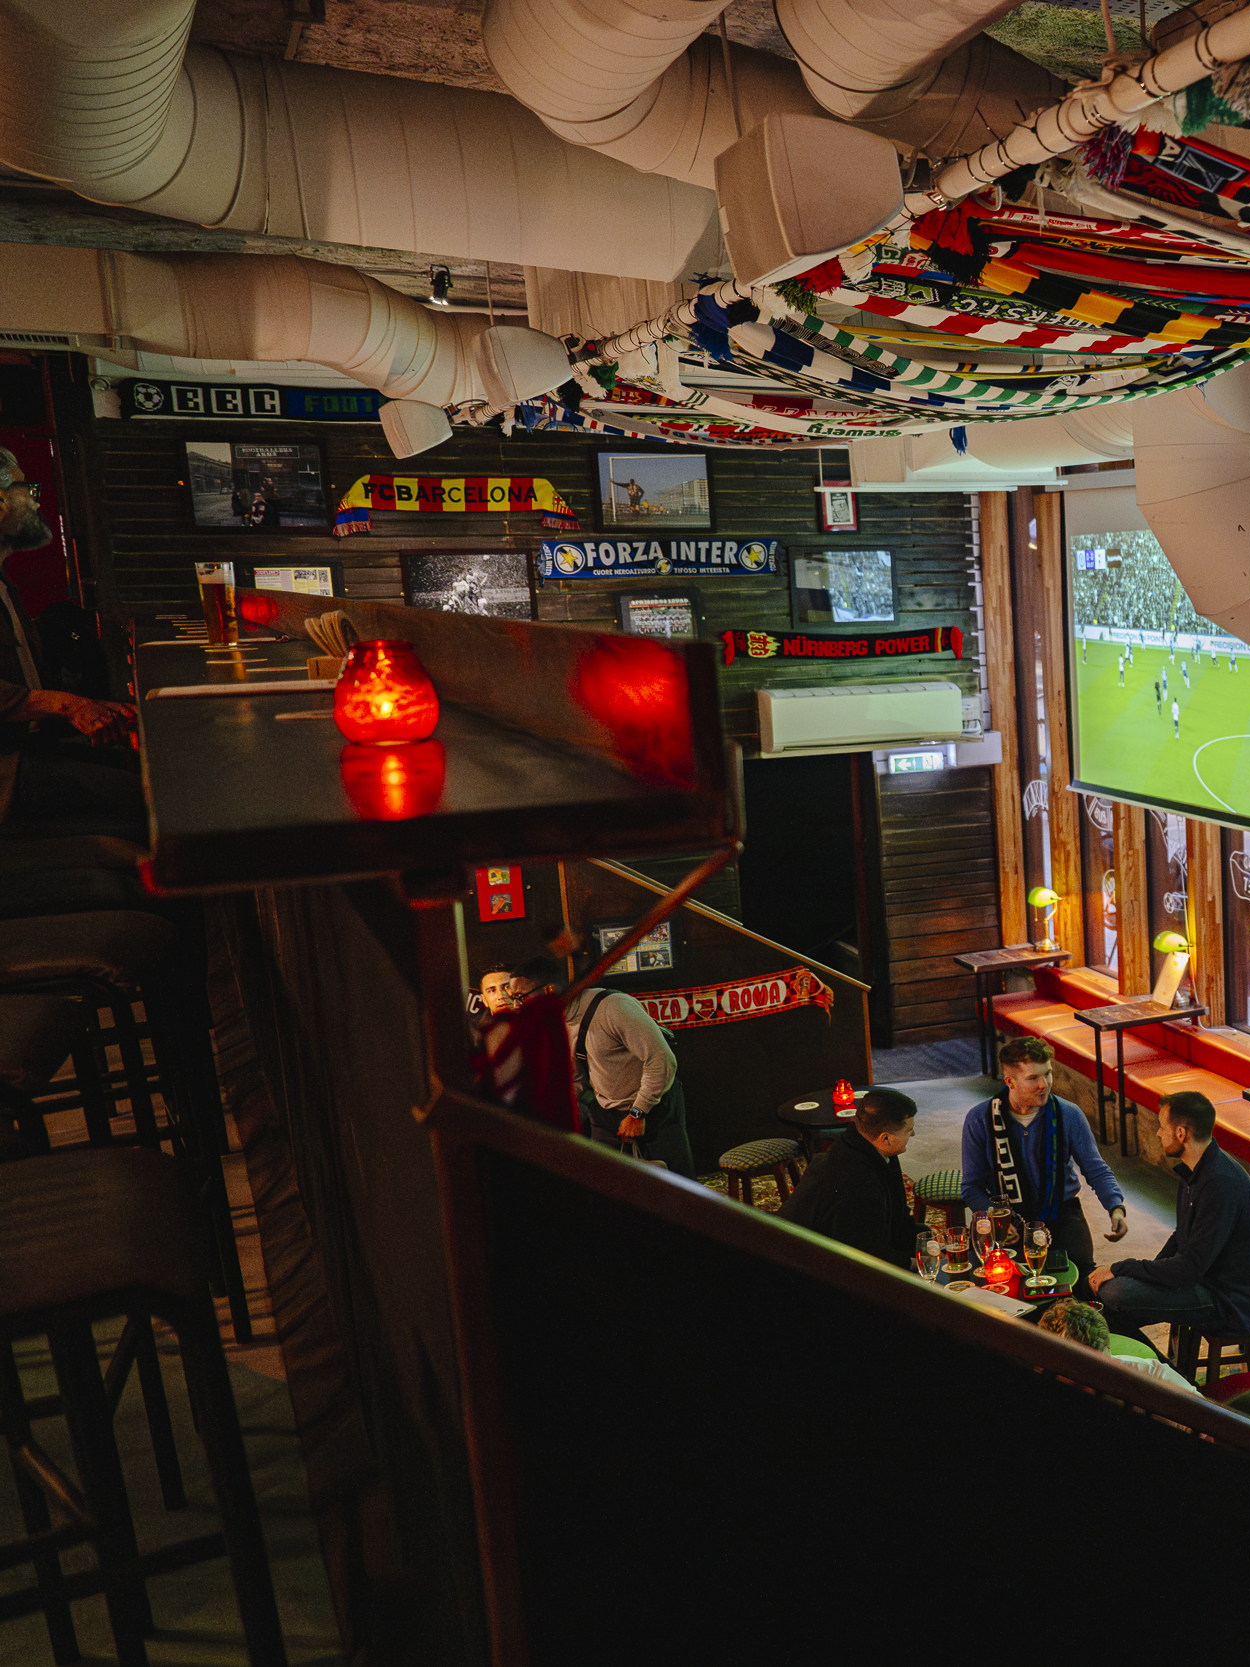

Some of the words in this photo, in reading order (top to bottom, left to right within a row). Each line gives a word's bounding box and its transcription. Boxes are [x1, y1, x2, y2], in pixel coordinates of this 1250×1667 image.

[170, 385, 280, 416] BBC
[304, 395, 384, 414] FOOT
[807, 423, 902, 438] Brewery
[583, 541, 664, 567] FORZA
[670, 540, 738, 565] INTER
[783, 635, 868, 657] NÜRNBERG
[875, 635, 930, 655] POWER
[1210, 640, 1247, 650] PRECISION
[728, 982, 781, 1012] ROMA
